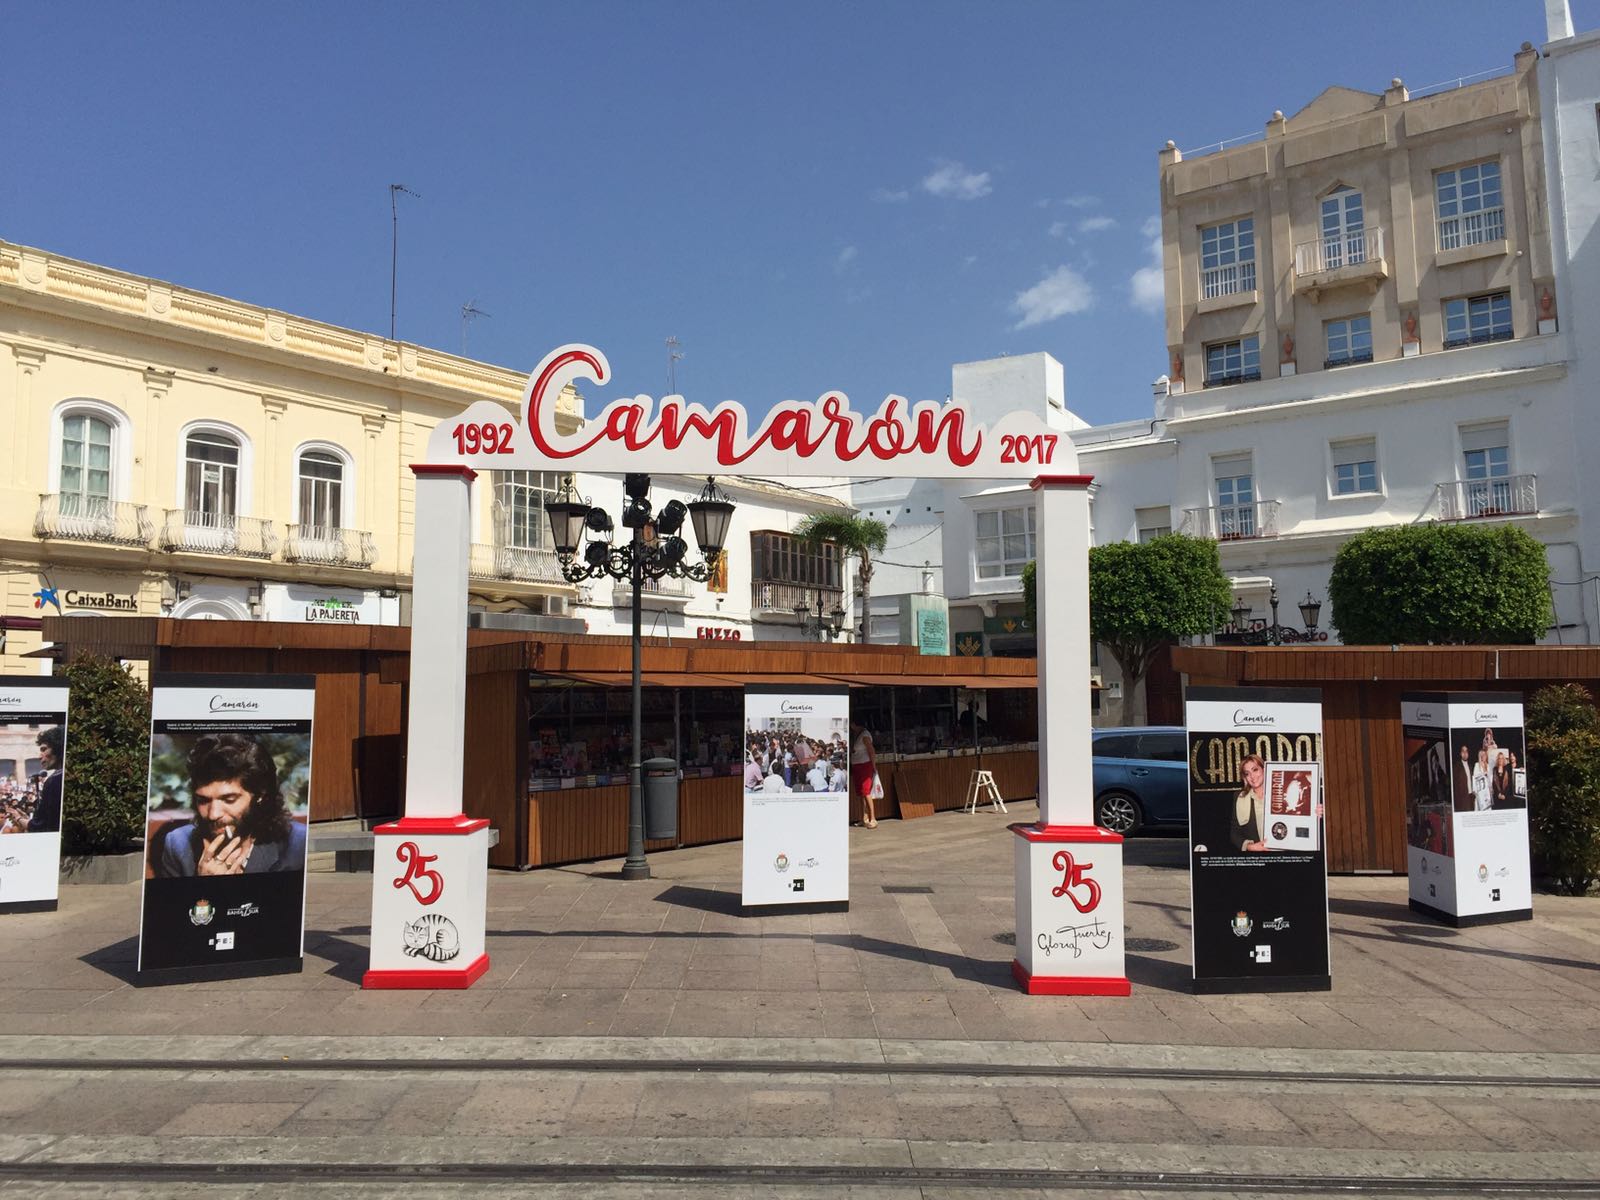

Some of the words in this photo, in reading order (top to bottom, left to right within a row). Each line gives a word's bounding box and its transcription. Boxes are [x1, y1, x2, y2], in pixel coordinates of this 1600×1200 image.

[452, 422, 514, 455] 1992
[528, 350, 982, 467] Camarón
[1000, 434, 1058, 464] 2017
[65, 590, 137, 608] CaixaBank
[305, 606, 317, 621] LA
[320, 608, 360, 624] PAJERETA
[393, 841, 444, 906] 25
[1052, 850, 1102, 914] 25
